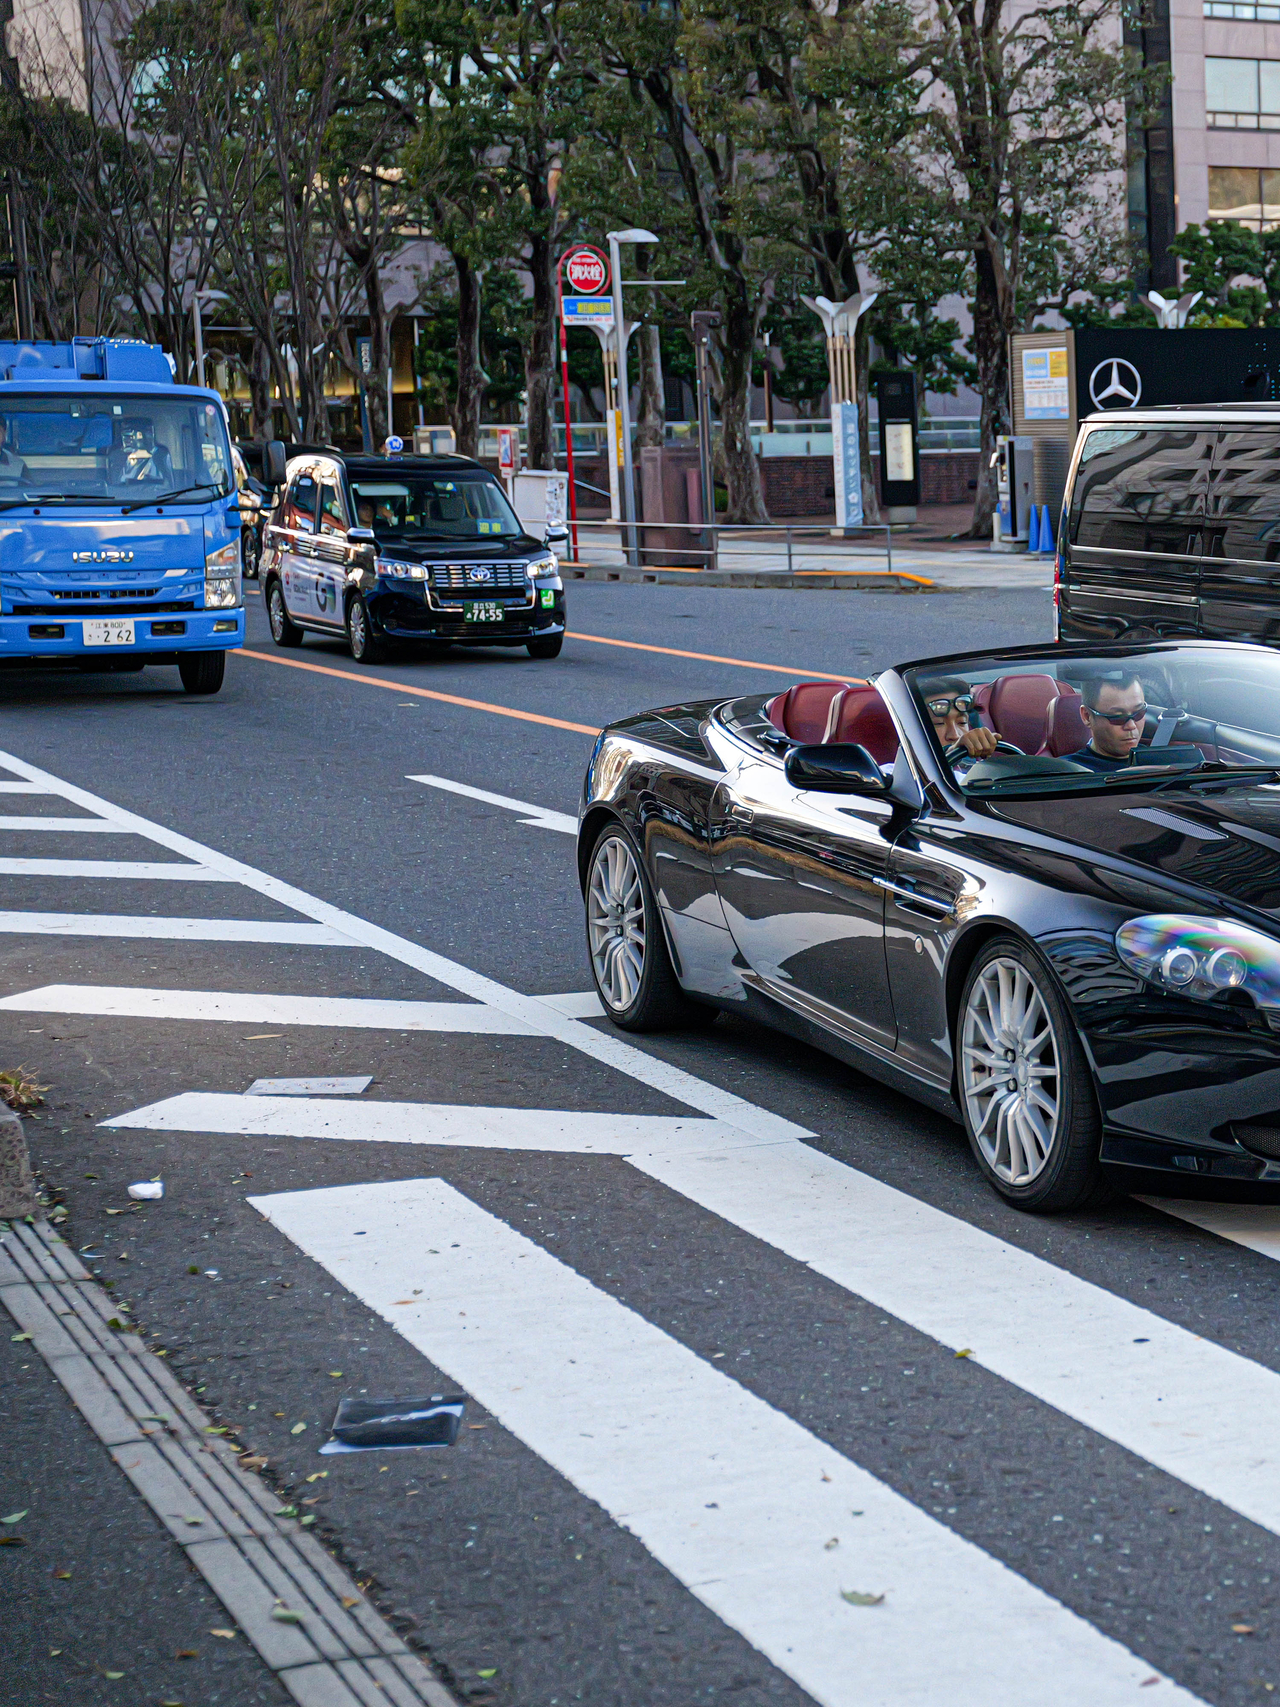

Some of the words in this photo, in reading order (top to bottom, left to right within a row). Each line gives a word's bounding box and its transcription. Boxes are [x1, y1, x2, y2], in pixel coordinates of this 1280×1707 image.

[571, 264, 602, 281] 消火栓
[72, 551, 134, 563] ISUZU
